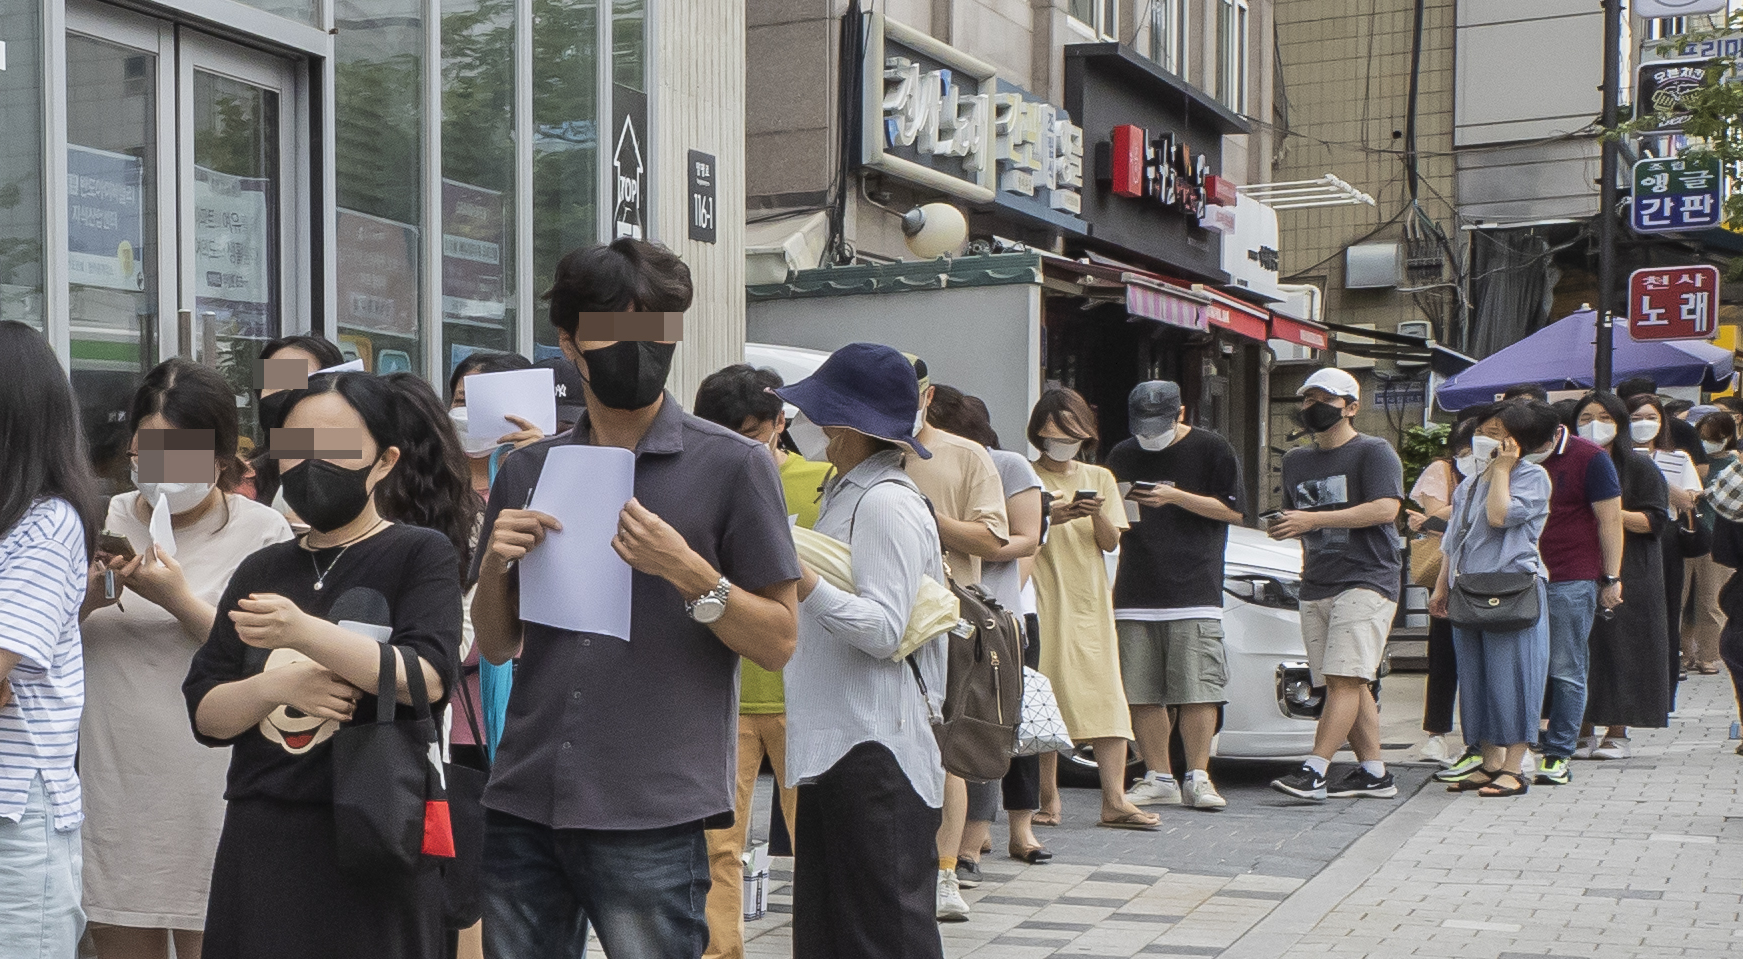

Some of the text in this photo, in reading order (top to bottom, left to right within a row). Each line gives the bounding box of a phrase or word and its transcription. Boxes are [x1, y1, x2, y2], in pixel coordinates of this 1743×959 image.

[619, 175, 637, 202] TOP
[1640, 170, 1715, 193] 앵글
[693, 193, 713, 230] 116-1
[1640, 194, 1714, 226] 간판
[1641, 273, 1709, 290] 천사
[1636, 291, 1710, 332] 노래
